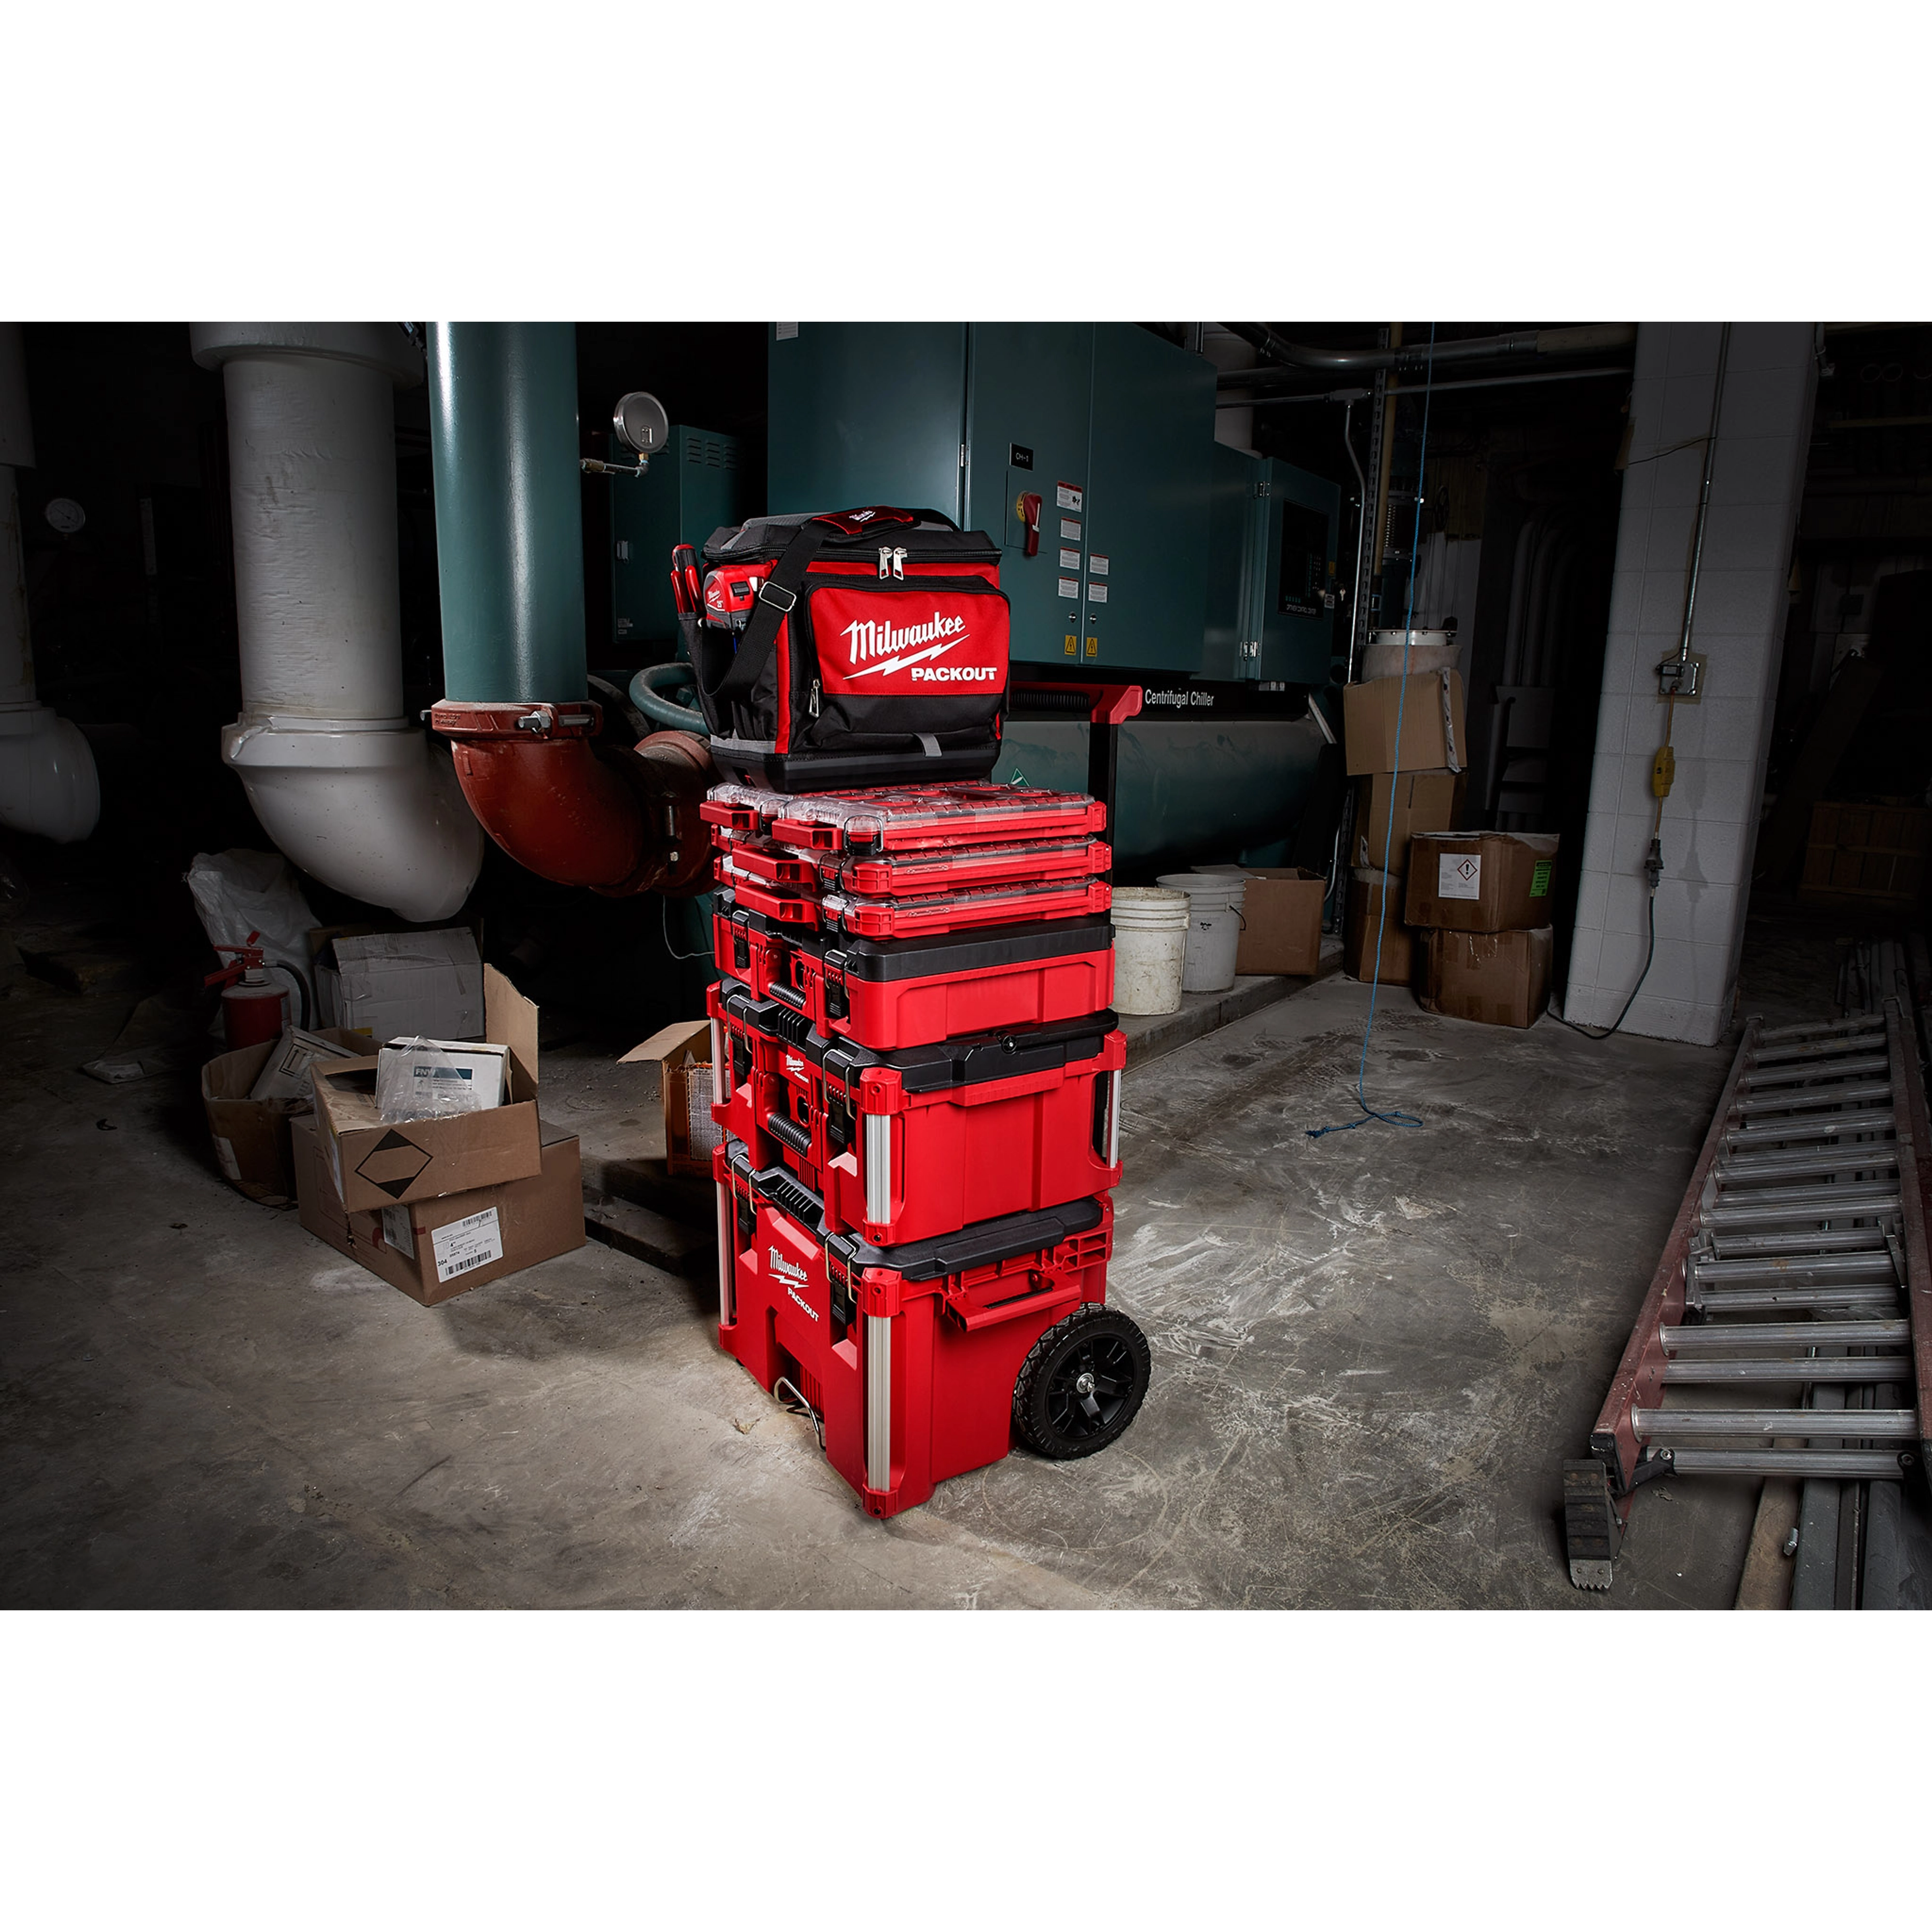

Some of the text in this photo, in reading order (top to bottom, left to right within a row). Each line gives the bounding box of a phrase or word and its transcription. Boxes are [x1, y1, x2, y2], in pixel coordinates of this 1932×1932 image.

[840, 611, 966, 665] Milwaukee
[911, 667, 997, 681] PACKOUT
[1145, 689, 1214, 708] Centrifugal Chiller
[768, 1245, 808, 1281] Milwaukee
[787, 1286, 820, 1322] PACKOUT
